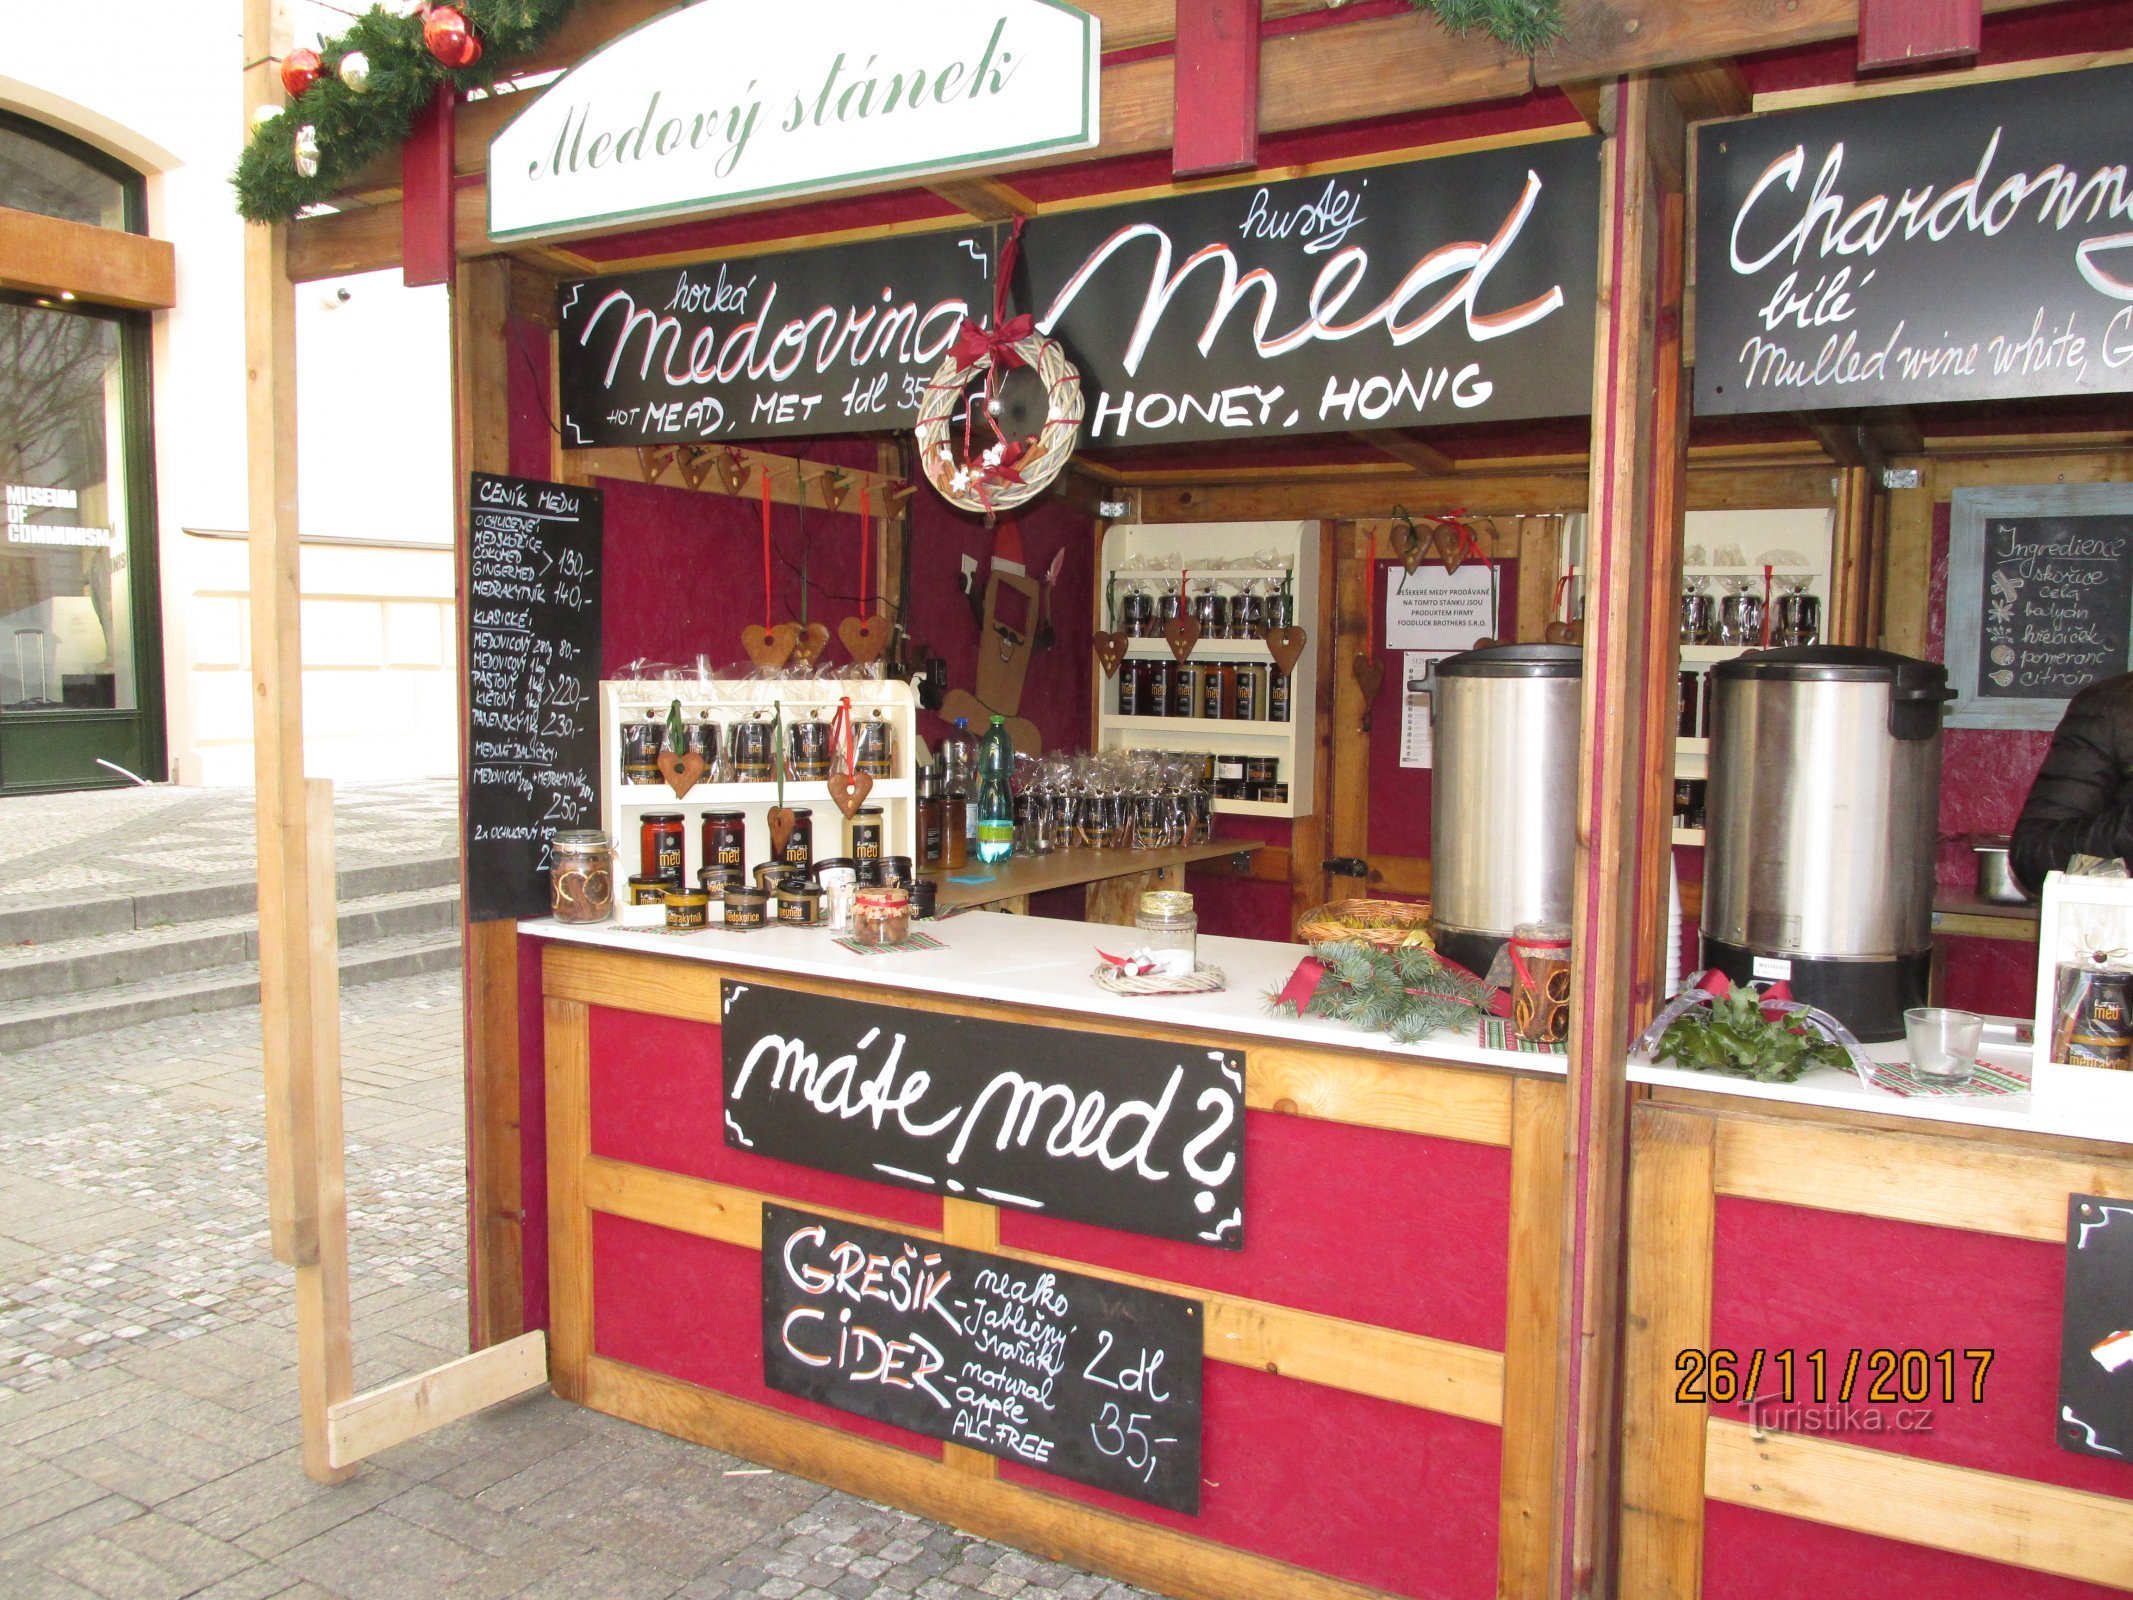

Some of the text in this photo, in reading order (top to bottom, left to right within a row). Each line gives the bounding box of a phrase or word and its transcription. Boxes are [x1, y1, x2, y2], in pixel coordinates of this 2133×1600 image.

[528, 16, 1026, 180] Medový stánek
[664, 262, 758, 316] horká
[1758, 266, 1876, 331] bílé
[1896, 331, 1977, 379] wine
[1988, 307, 2088, 382] white,
[606, 406, 640, 427] HOT
[642, 401, 736, 436] MEAD,
[750, 391, 823, 425] MET
[1093, 363, 1493, 439] HONEY, HONIG
[6, 485, 77, 508] MUSEUM
[7, 505, 27, 523] OF
[480, 481, 579, 513] CENÍK MEDU
[8, 524, 110, 546] COMMUNISM
[1997, 525, 2126, 578] Ingredience
[472, 561, 535, 581] GINGERMED
[731, 1027, 962, 1137] máte
[956, 1386, 1029, 1425] apple
[962, 1361, 1055, 1410] natural
